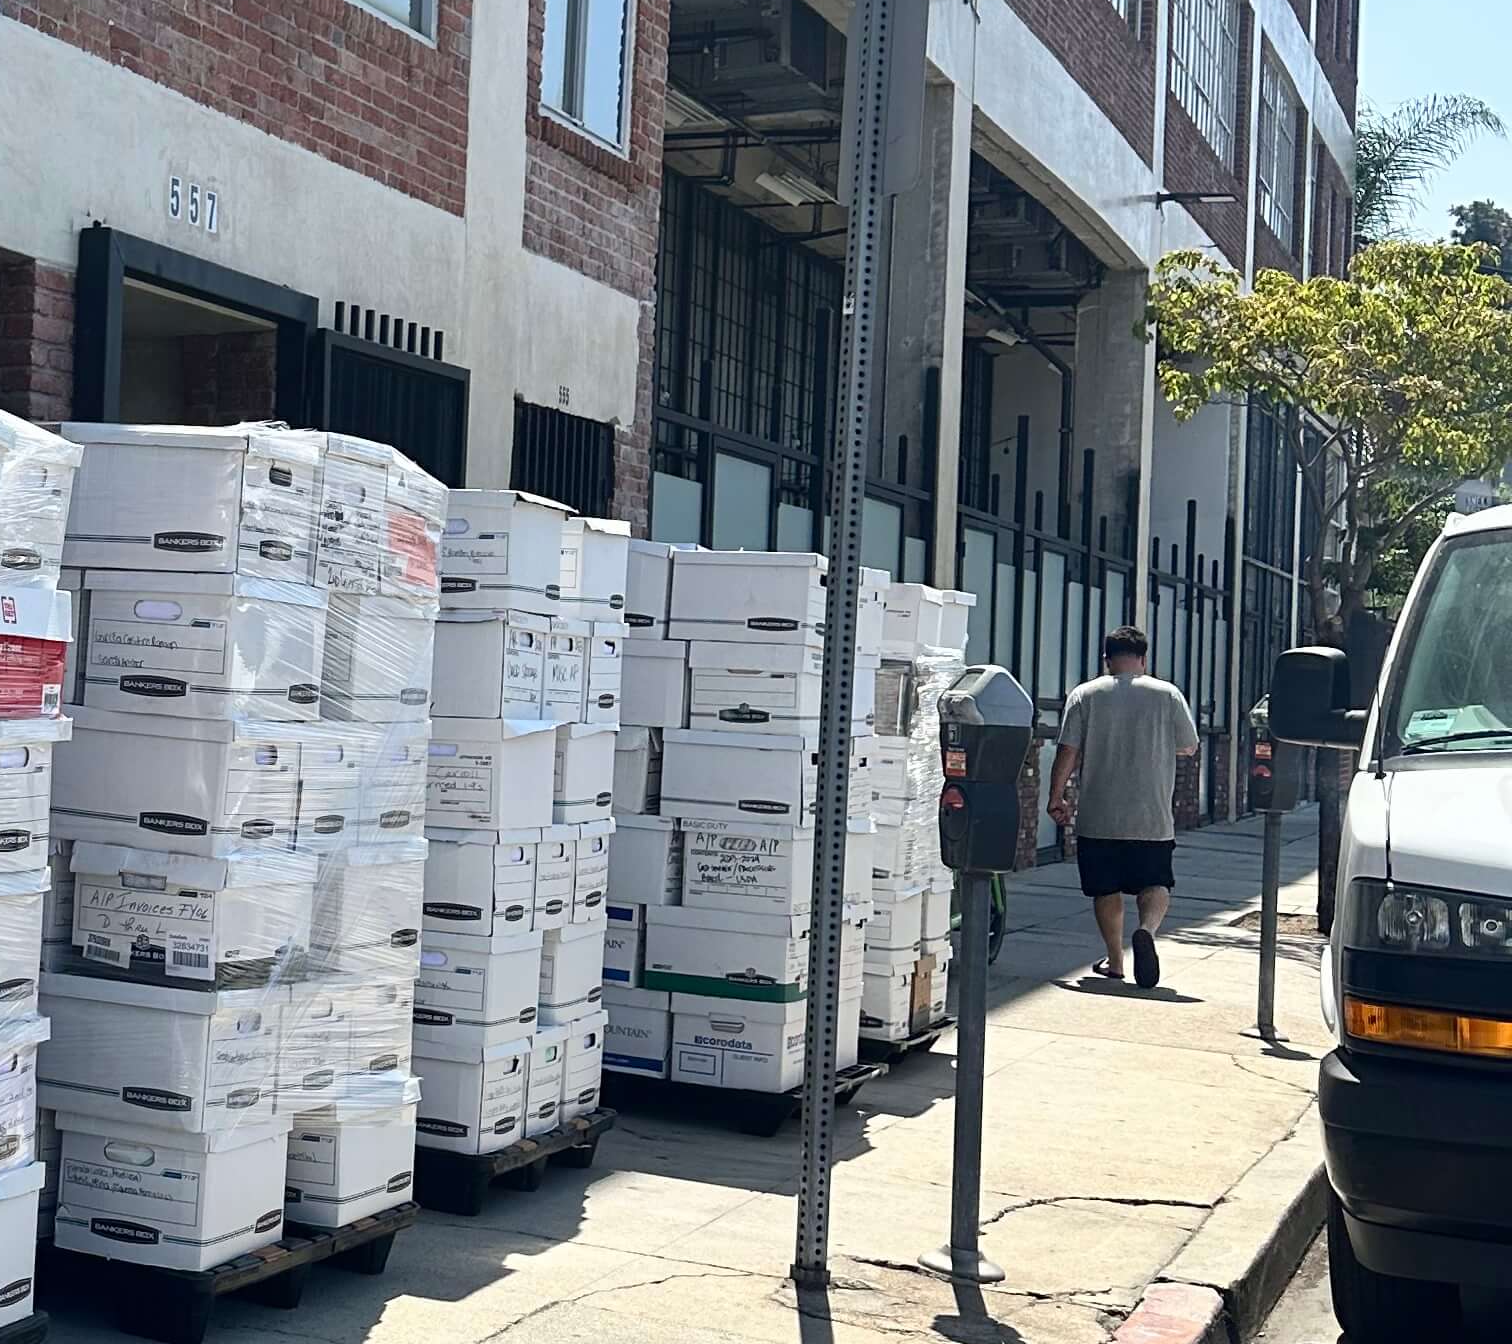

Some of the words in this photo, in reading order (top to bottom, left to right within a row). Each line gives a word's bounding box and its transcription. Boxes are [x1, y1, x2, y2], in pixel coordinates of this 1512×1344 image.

[170, 177, 216, 230] 557
[158, 538, 199, 546] BANKERS
[123, 681, 162, 690] BANKERS
[143, 816, 185, 829] BANKERS
[184, 821, 205, 831] BOX
[682, 820, 705, 829] BASIC
[707, 821, 728, 830] DUTY
[695, 831, 718, 850] A/P
[759, 838, 780, 856] A/P
[702, 1036, 753, 1051] corodata
[126, 1092, 168, 1103] BANKERS
[94, 1223, 136, 1237] BANKERS
[135, 1230, 155, 1240] BOX
